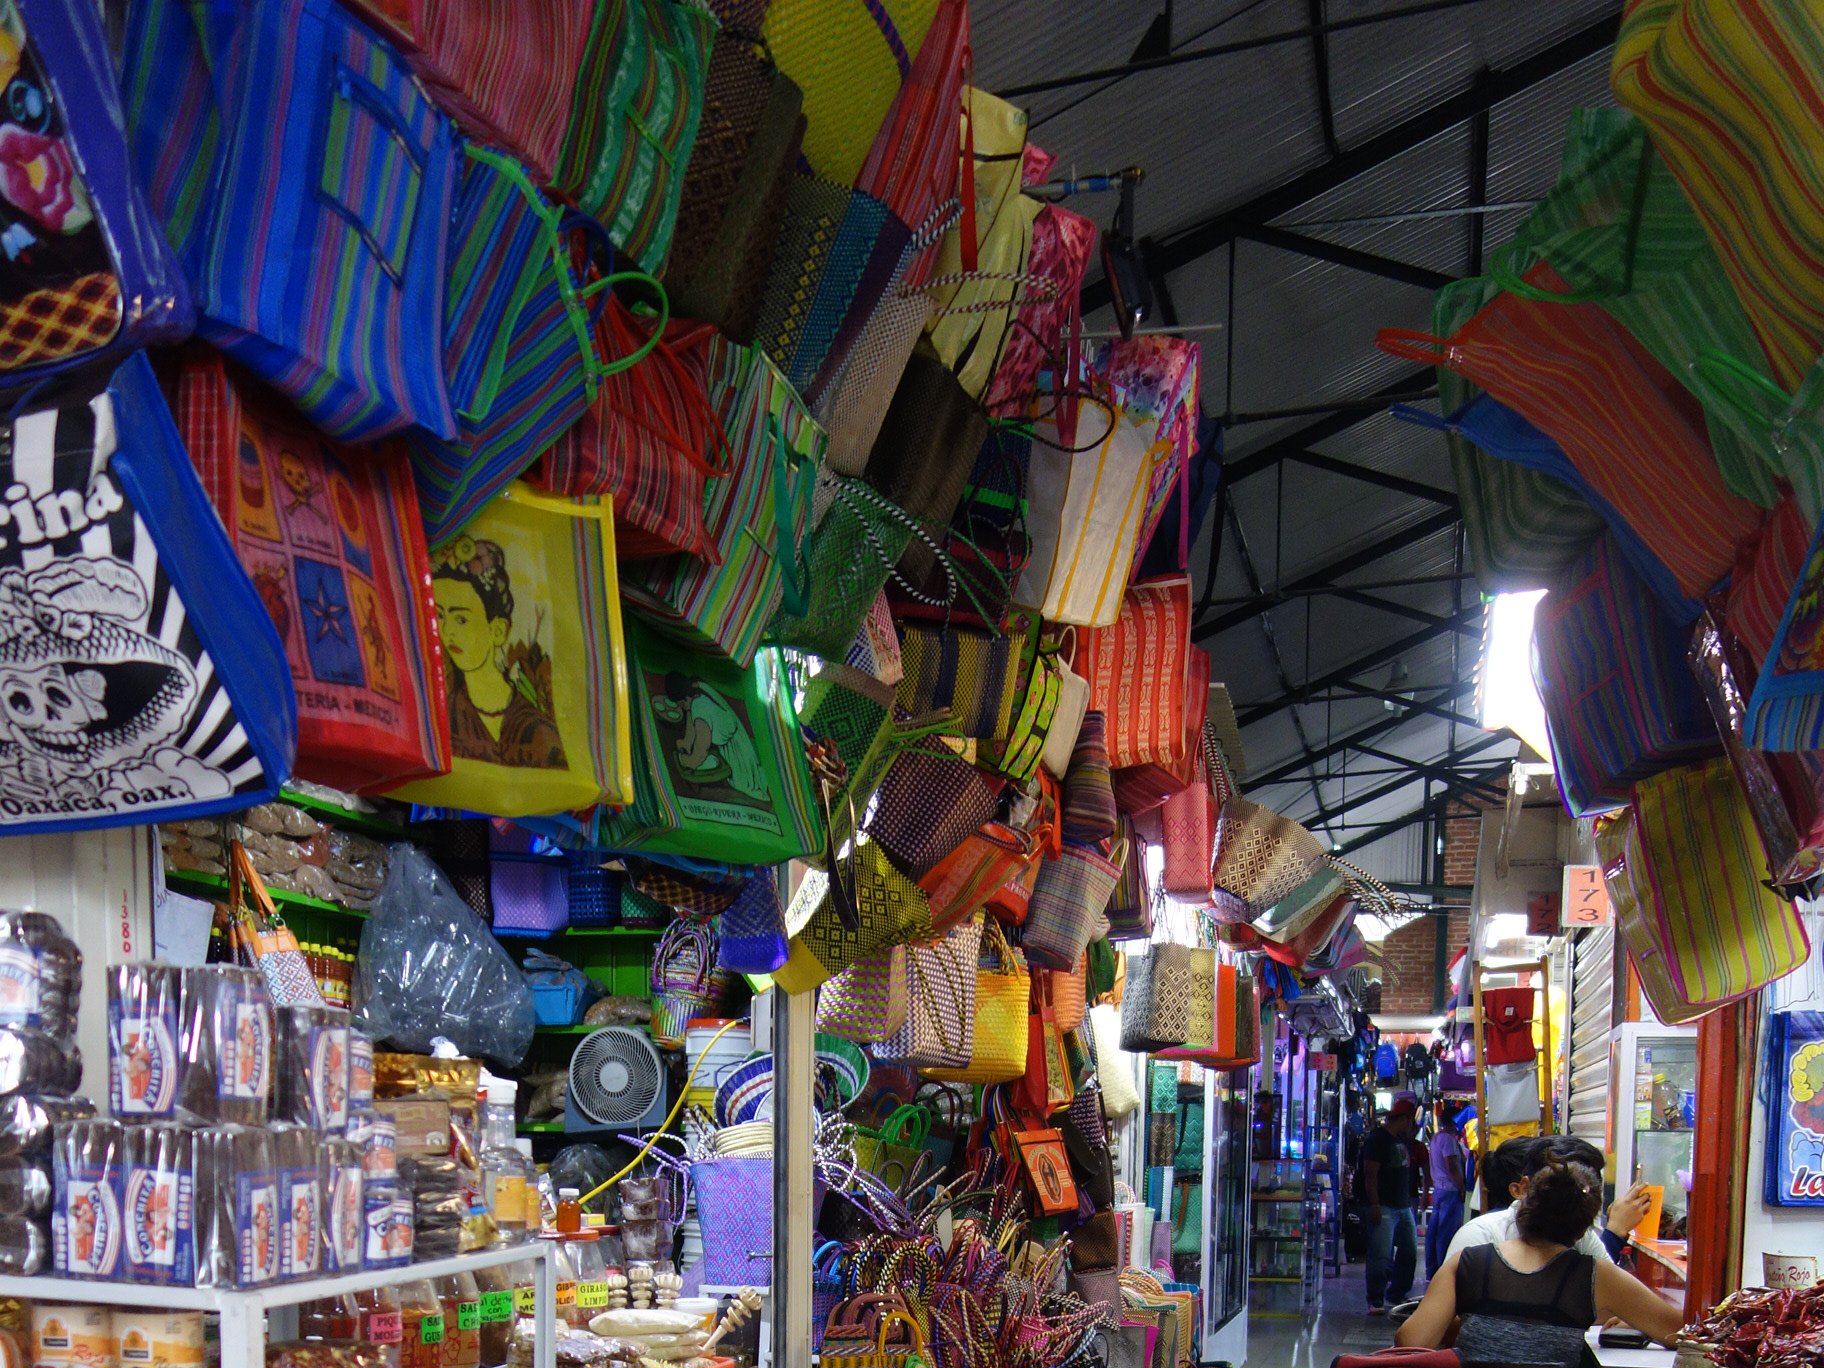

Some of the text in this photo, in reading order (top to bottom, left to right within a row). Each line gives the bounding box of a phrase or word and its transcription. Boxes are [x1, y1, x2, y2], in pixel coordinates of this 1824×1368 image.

[295, 690, 342, 712] TERIA
[121, 782, 186, 806] oax.
[134, 1174, 156, 1256] CONCHITA
[1788, 1265, 1811, 1286] Rojo
